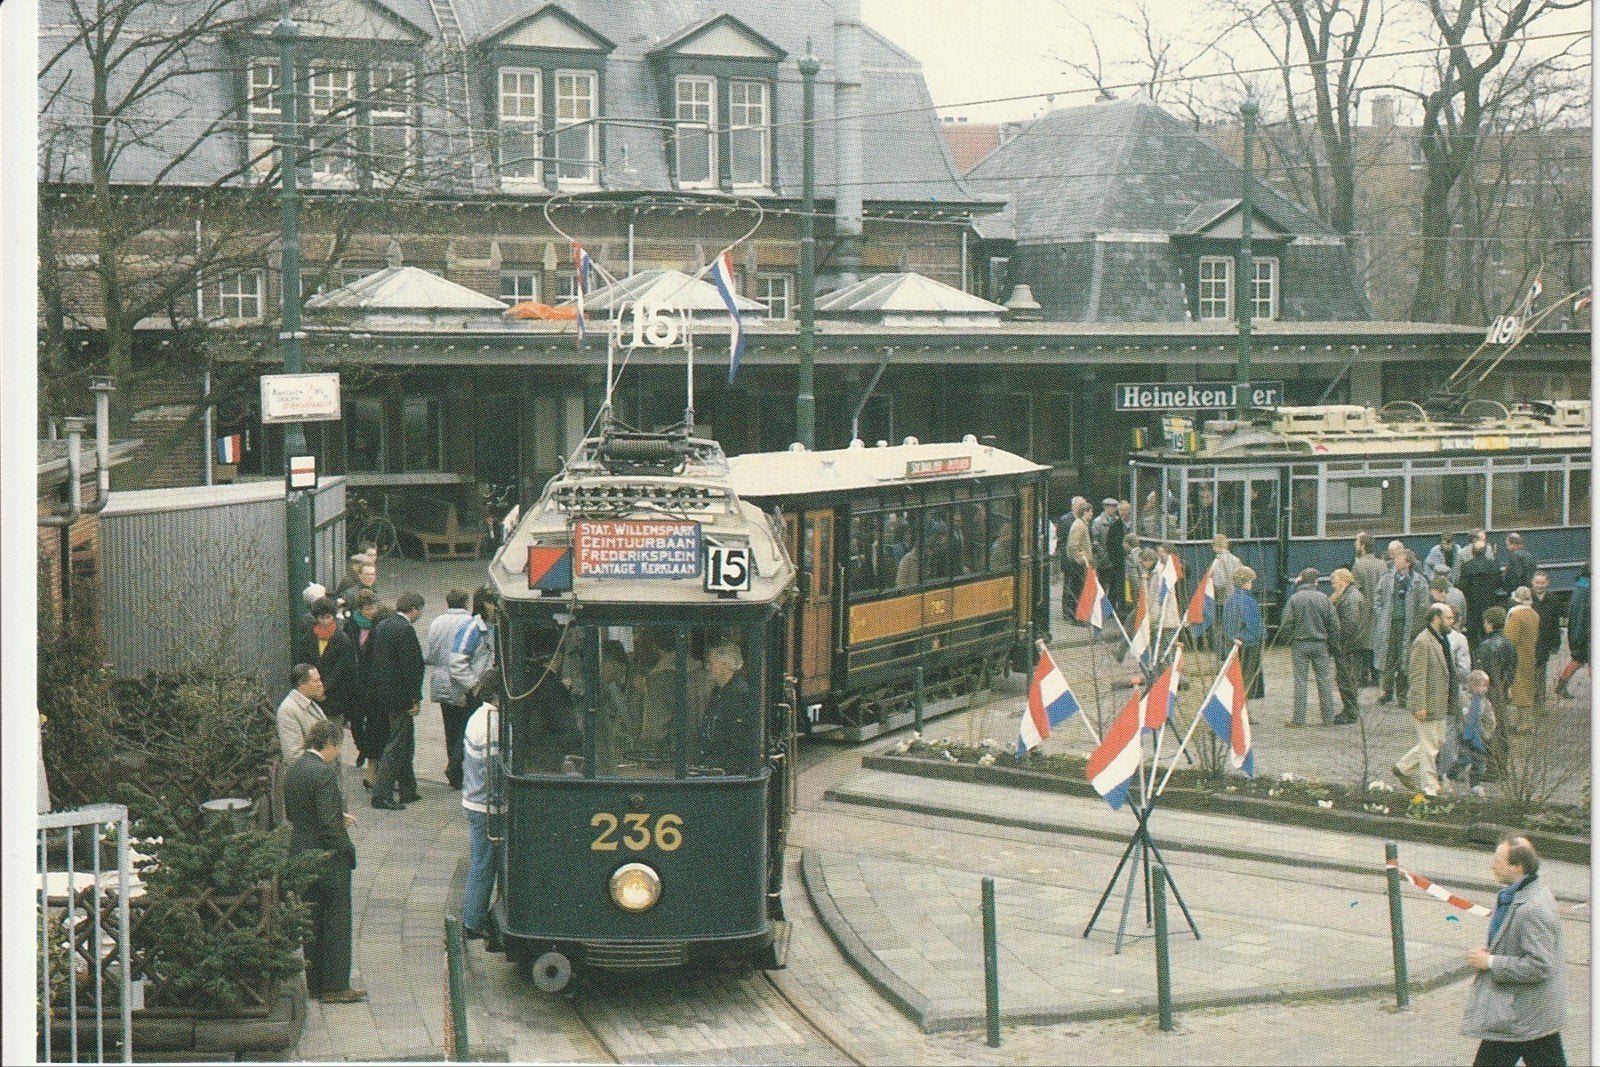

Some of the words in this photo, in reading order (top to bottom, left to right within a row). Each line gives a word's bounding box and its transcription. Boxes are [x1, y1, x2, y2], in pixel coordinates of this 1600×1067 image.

[631, 302, 678, 347] 15
[1489, 315, 1517, 343] 19
[1124, 386, 1228, 407] Heineken
[614, 524, 696, 536] WILLEMSPARK
[581, 537, 696, 549] CEINTUURBAAN
[581, 550, 696, 562] FREDERIKSPLEIN
[581, 563, 636, 575] PLANTAGE
[640, 562, 696, 575] KERKLAAN
[710, 549, 746, 587] 15
[591, 812, 684, 851] 236
